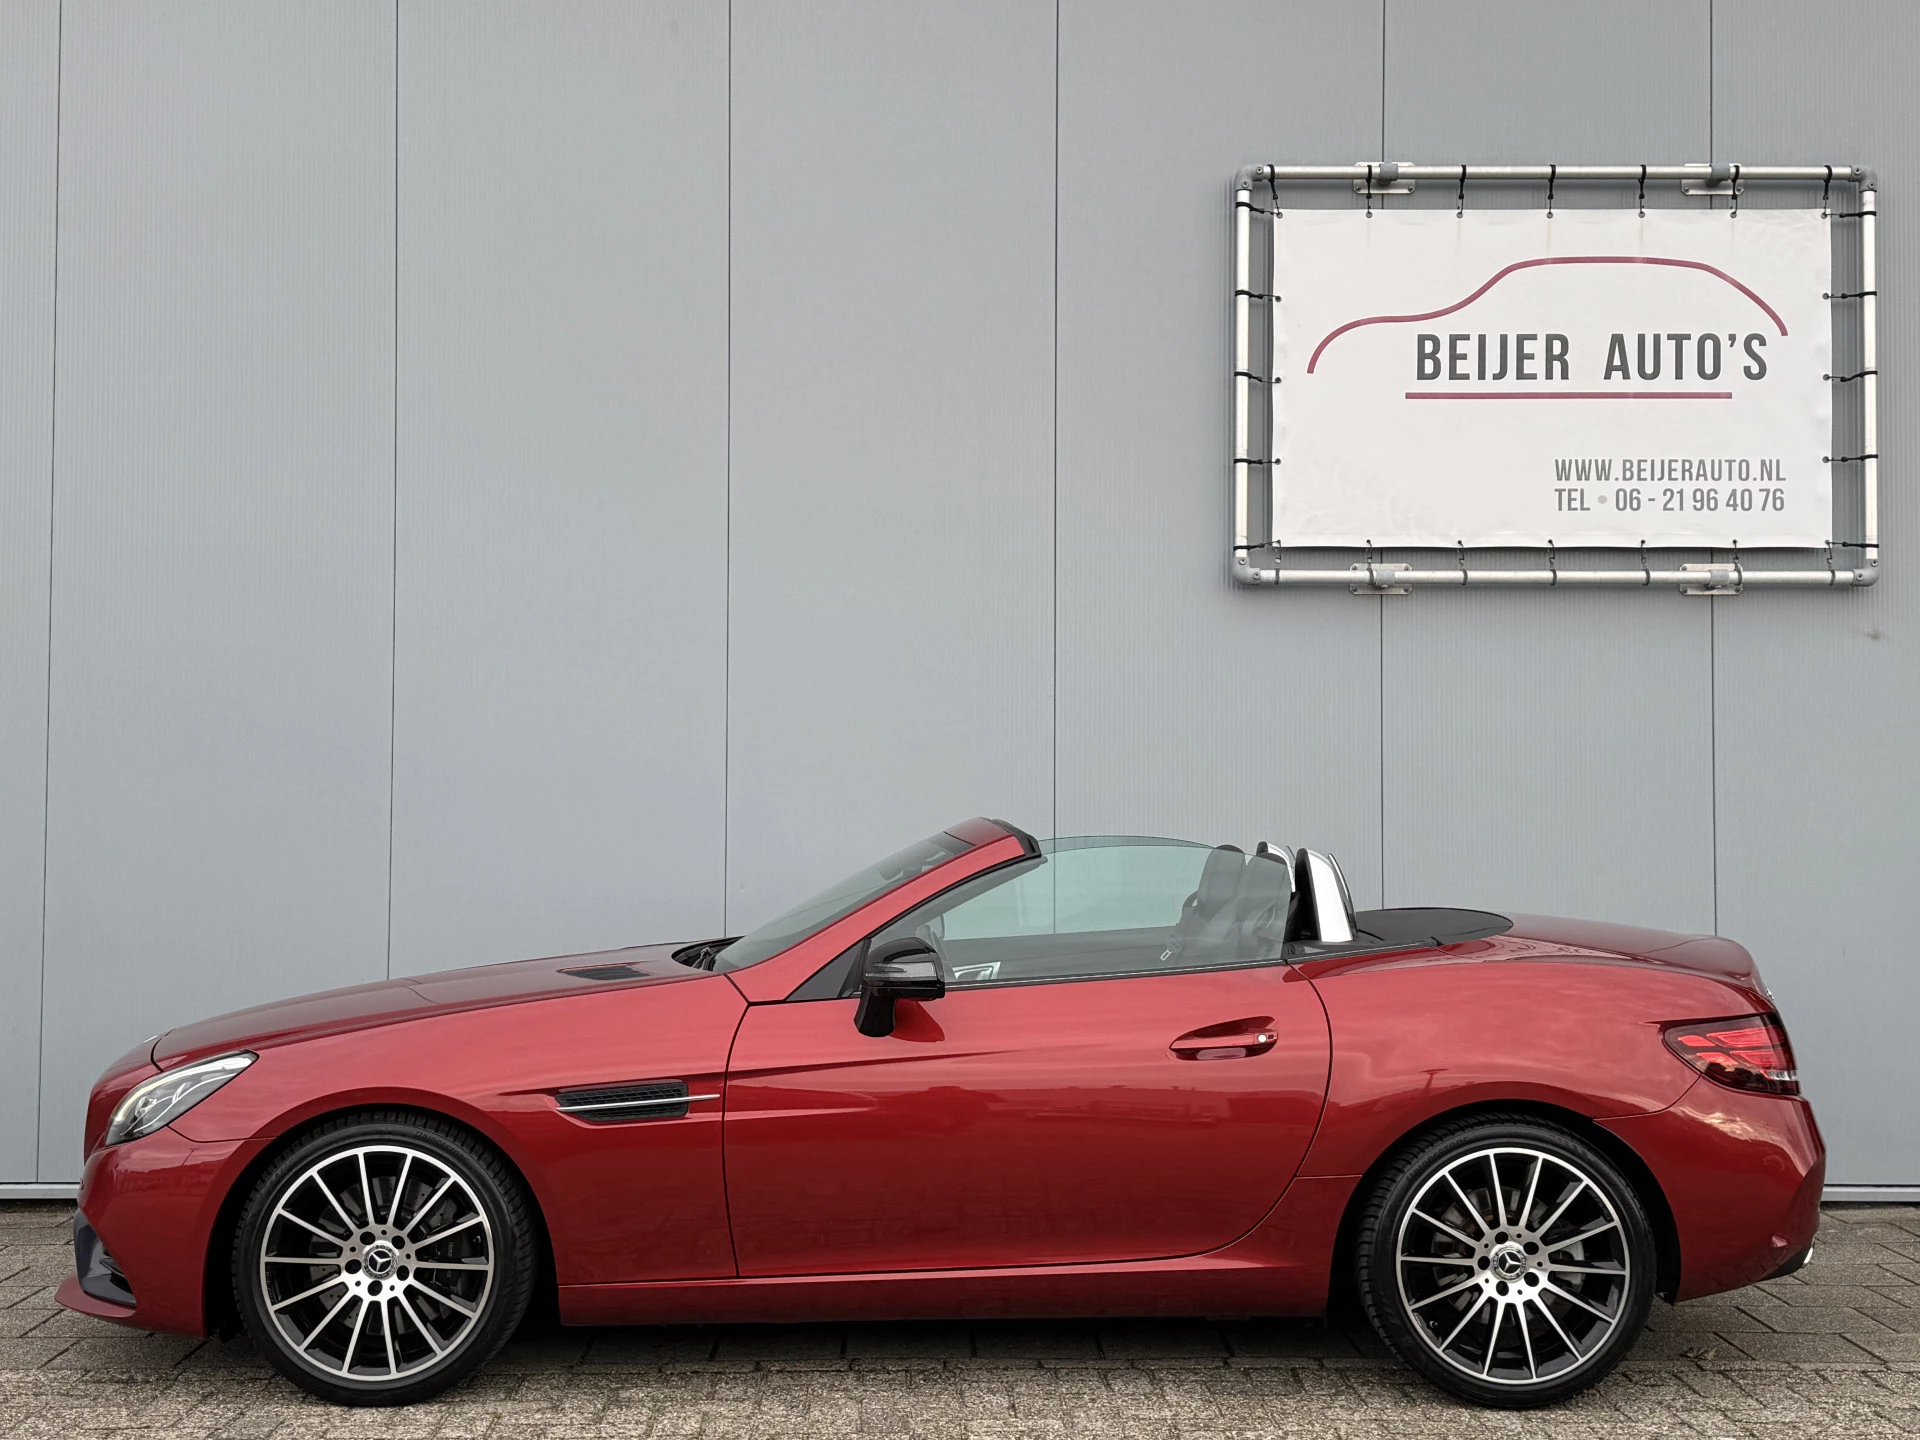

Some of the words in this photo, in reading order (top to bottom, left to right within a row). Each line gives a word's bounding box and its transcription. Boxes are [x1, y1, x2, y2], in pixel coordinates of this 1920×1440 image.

[1416, 333, 1570, 381] BEIJER
[1603, 333, 1768, 381] AUTO'S
[1554, 458, 1787, 482] WWW.BEIJERAUTO.NL
[1554, 488, 1591, 512] TEL
[1615, 488, 1642, 512] 06
[1662, 488, 1684, 512] 21
[1692, 488, 1719, 512] 96
[1725, 488, 1753, 512] 40
[1758, 488, 1785, 512] 76
